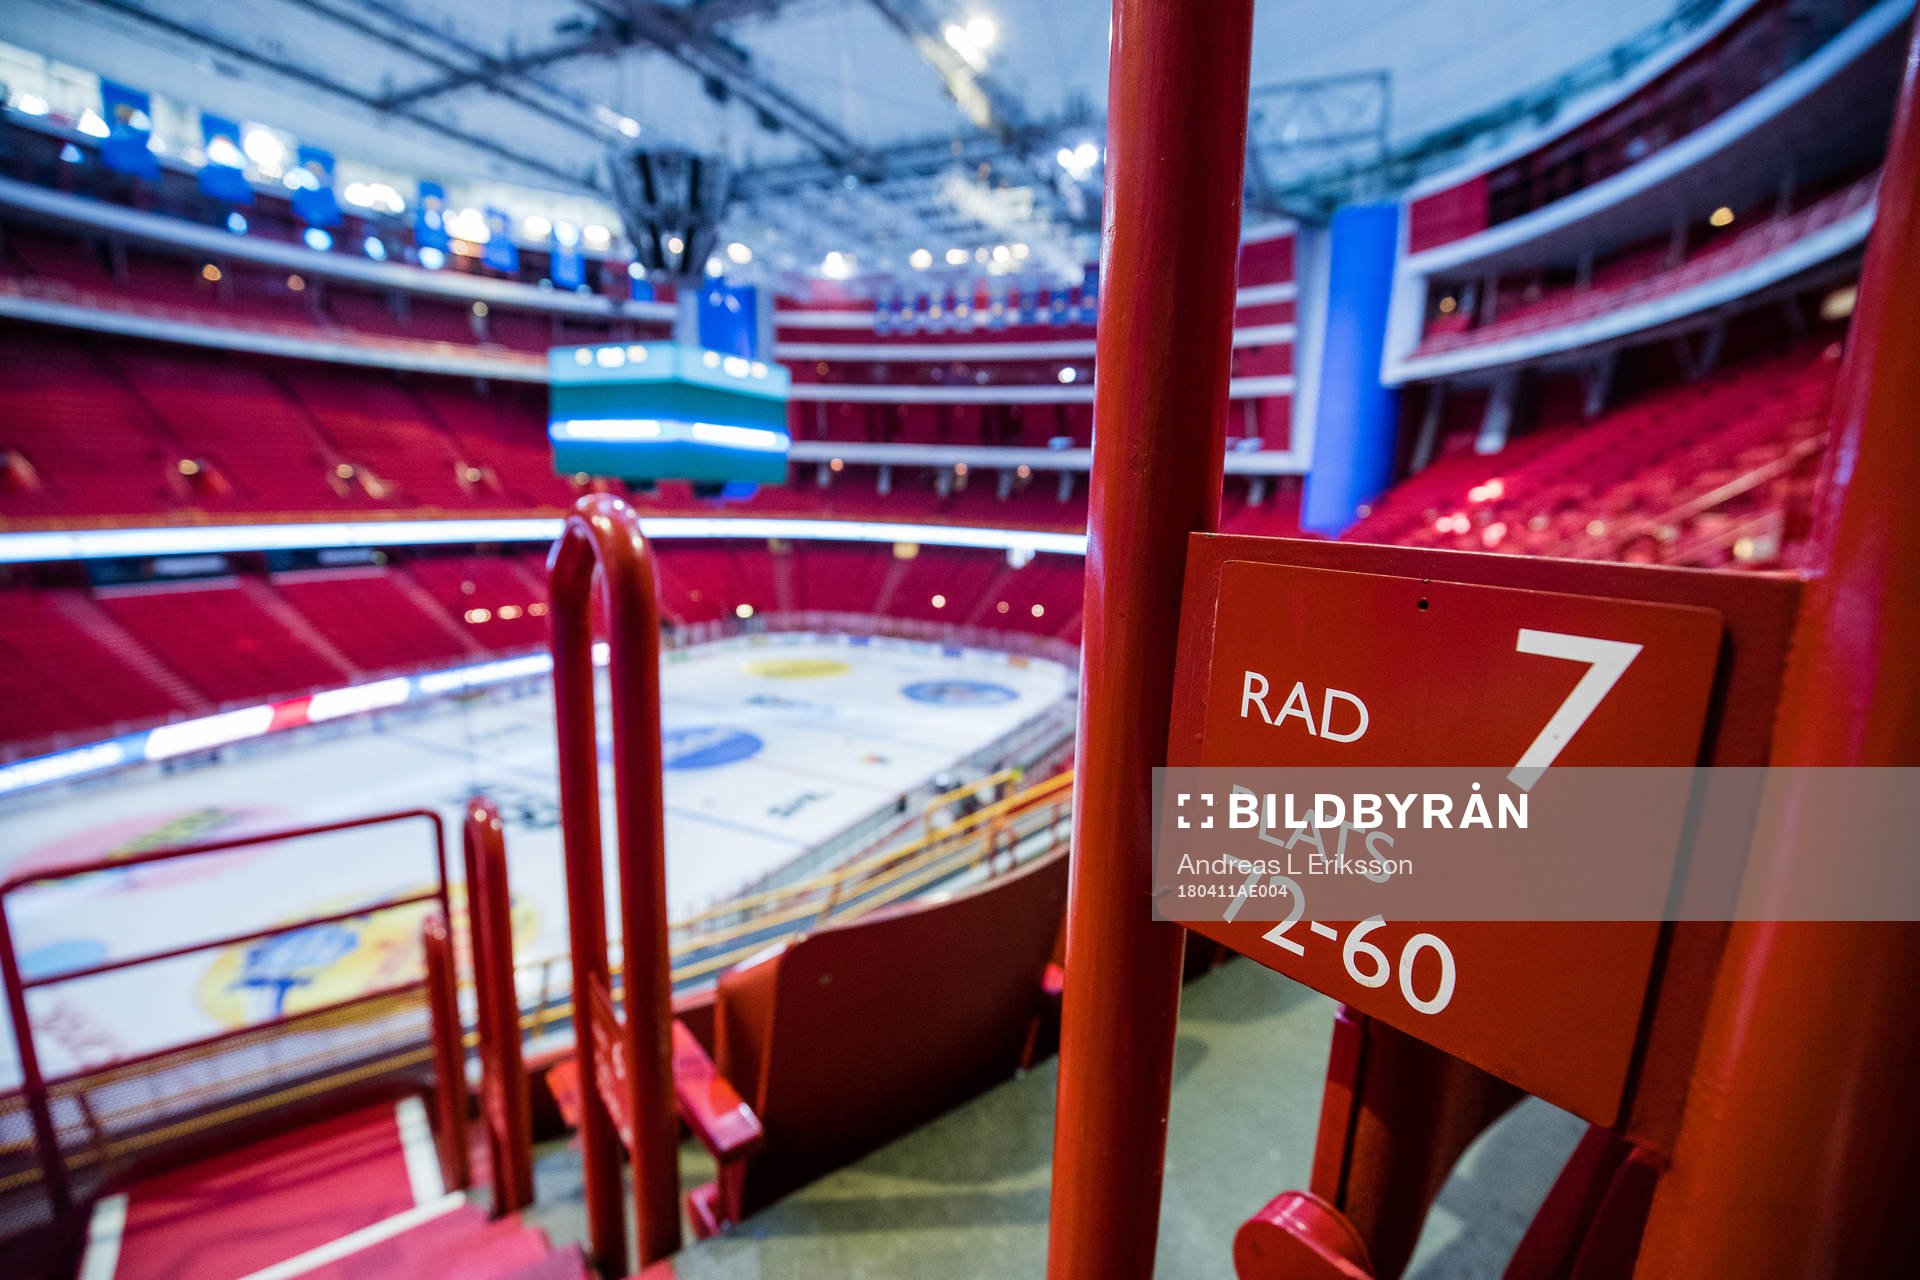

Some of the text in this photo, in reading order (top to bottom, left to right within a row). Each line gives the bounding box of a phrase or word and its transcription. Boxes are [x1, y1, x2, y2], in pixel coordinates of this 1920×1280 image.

[1240, 628, 1644, 792] RAD 7
[1221, 853, 1457, 1015] 72-60
